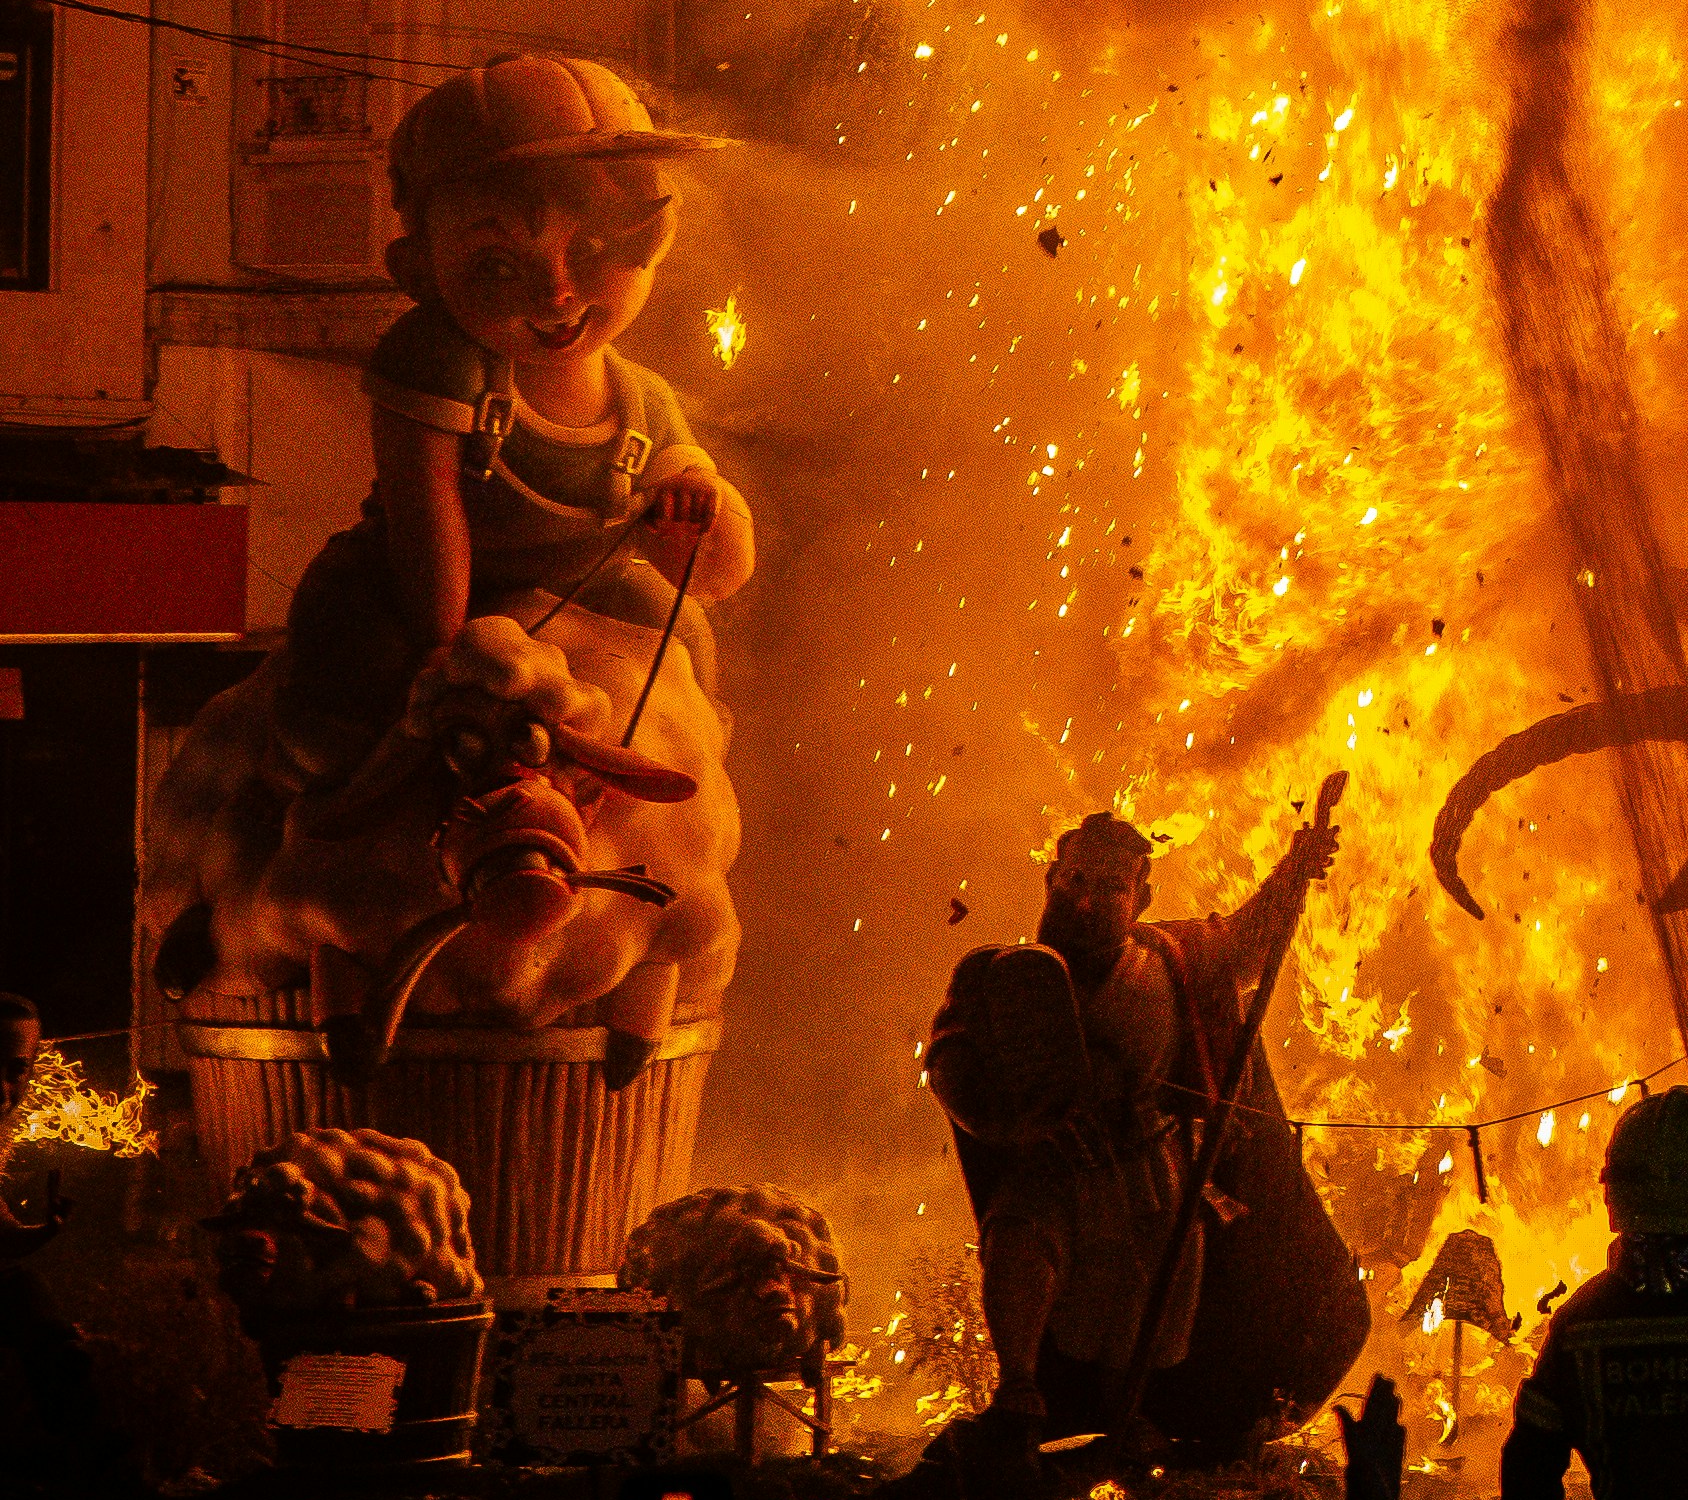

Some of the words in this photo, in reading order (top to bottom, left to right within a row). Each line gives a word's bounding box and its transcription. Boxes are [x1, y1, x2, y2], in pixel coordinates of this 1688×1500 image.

[553, 1372, 623, 1388] JUNTA
[537, 1394, 633, 1409] CENTRAL
[537, 1415, 629, 1430] FALLERA
